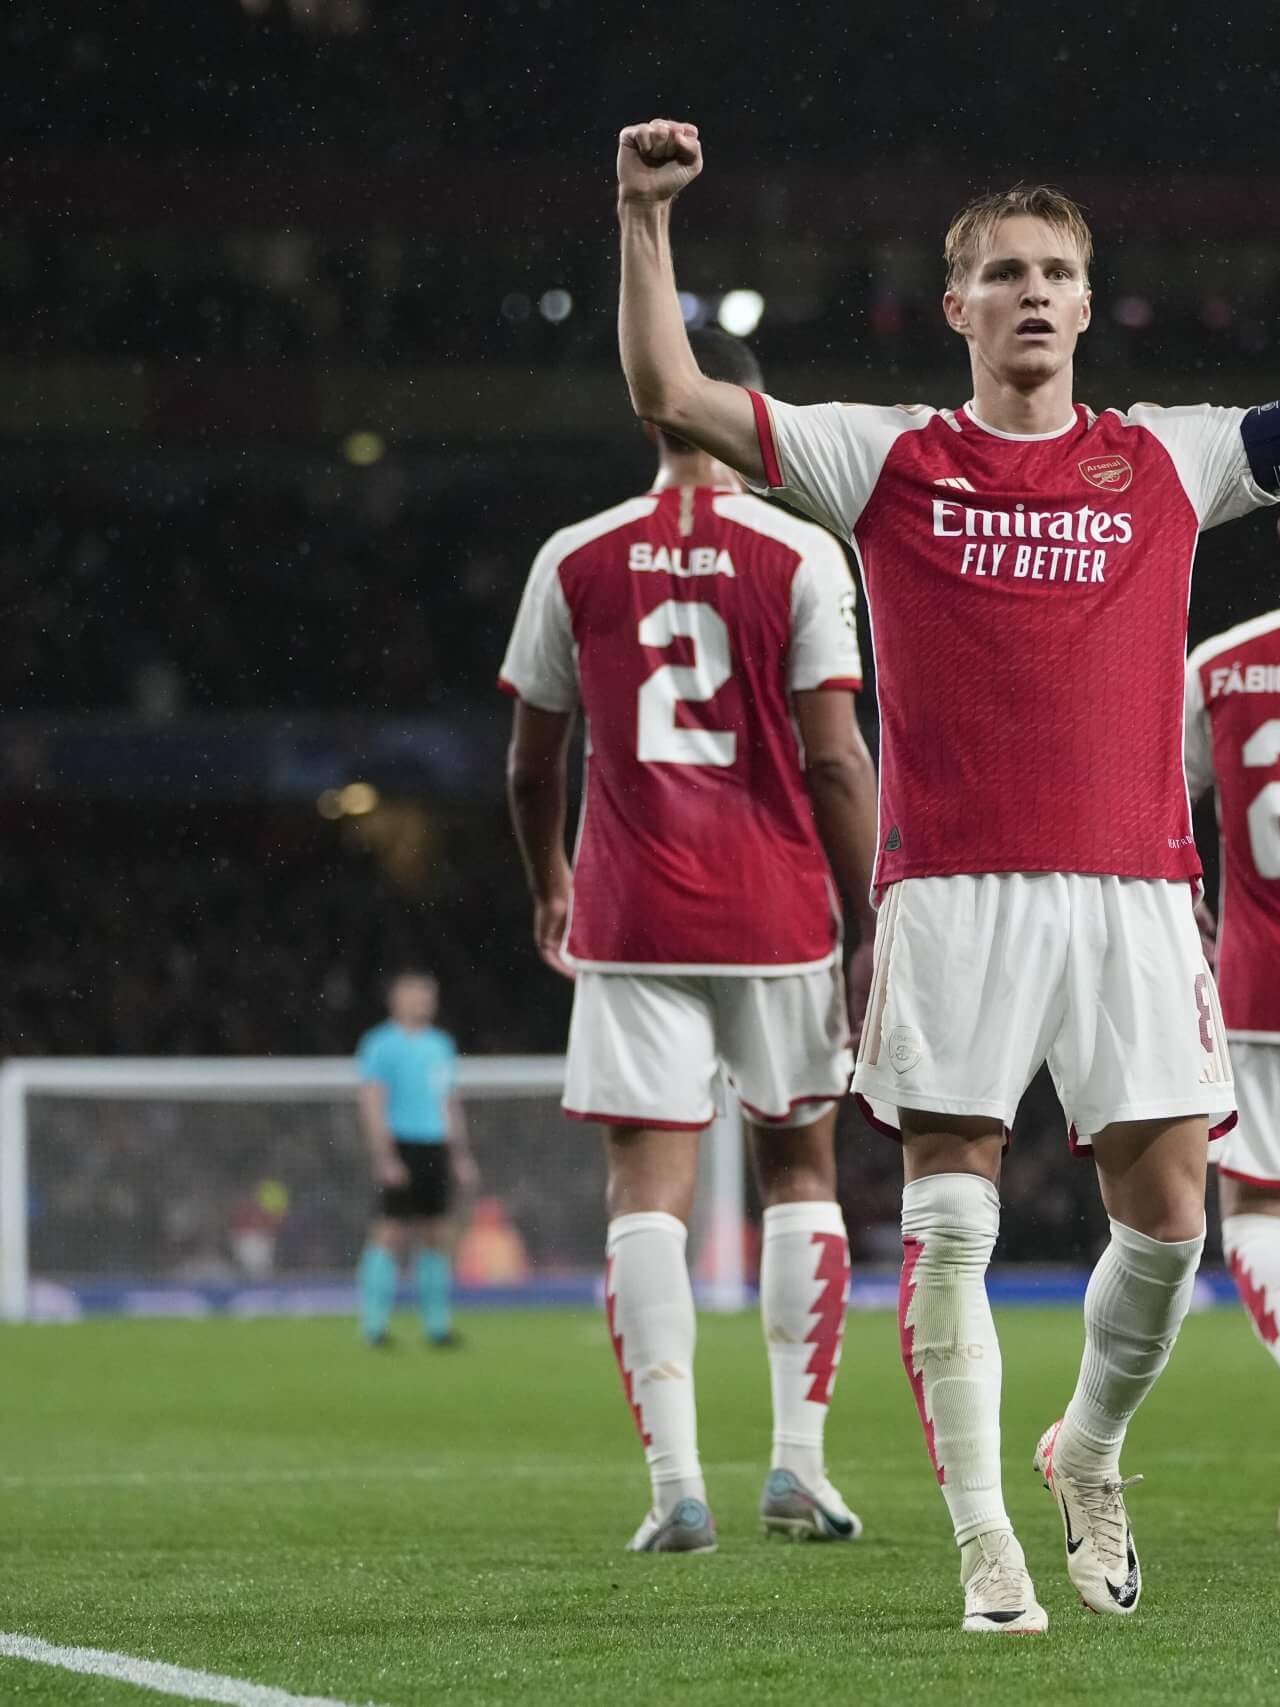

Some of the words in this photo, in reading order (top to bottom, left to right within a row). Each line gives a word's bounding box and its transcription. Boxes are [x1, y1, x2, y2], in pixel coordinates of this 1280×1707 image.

[1087, 460, 1121, 472] Arsenal
[932, 499, 1133, 544] Emirates
[960, 543, 1007, 576] FLY
[1013, 545, 1106, 583] BETTER
[637, 599, 736, 767] 2
